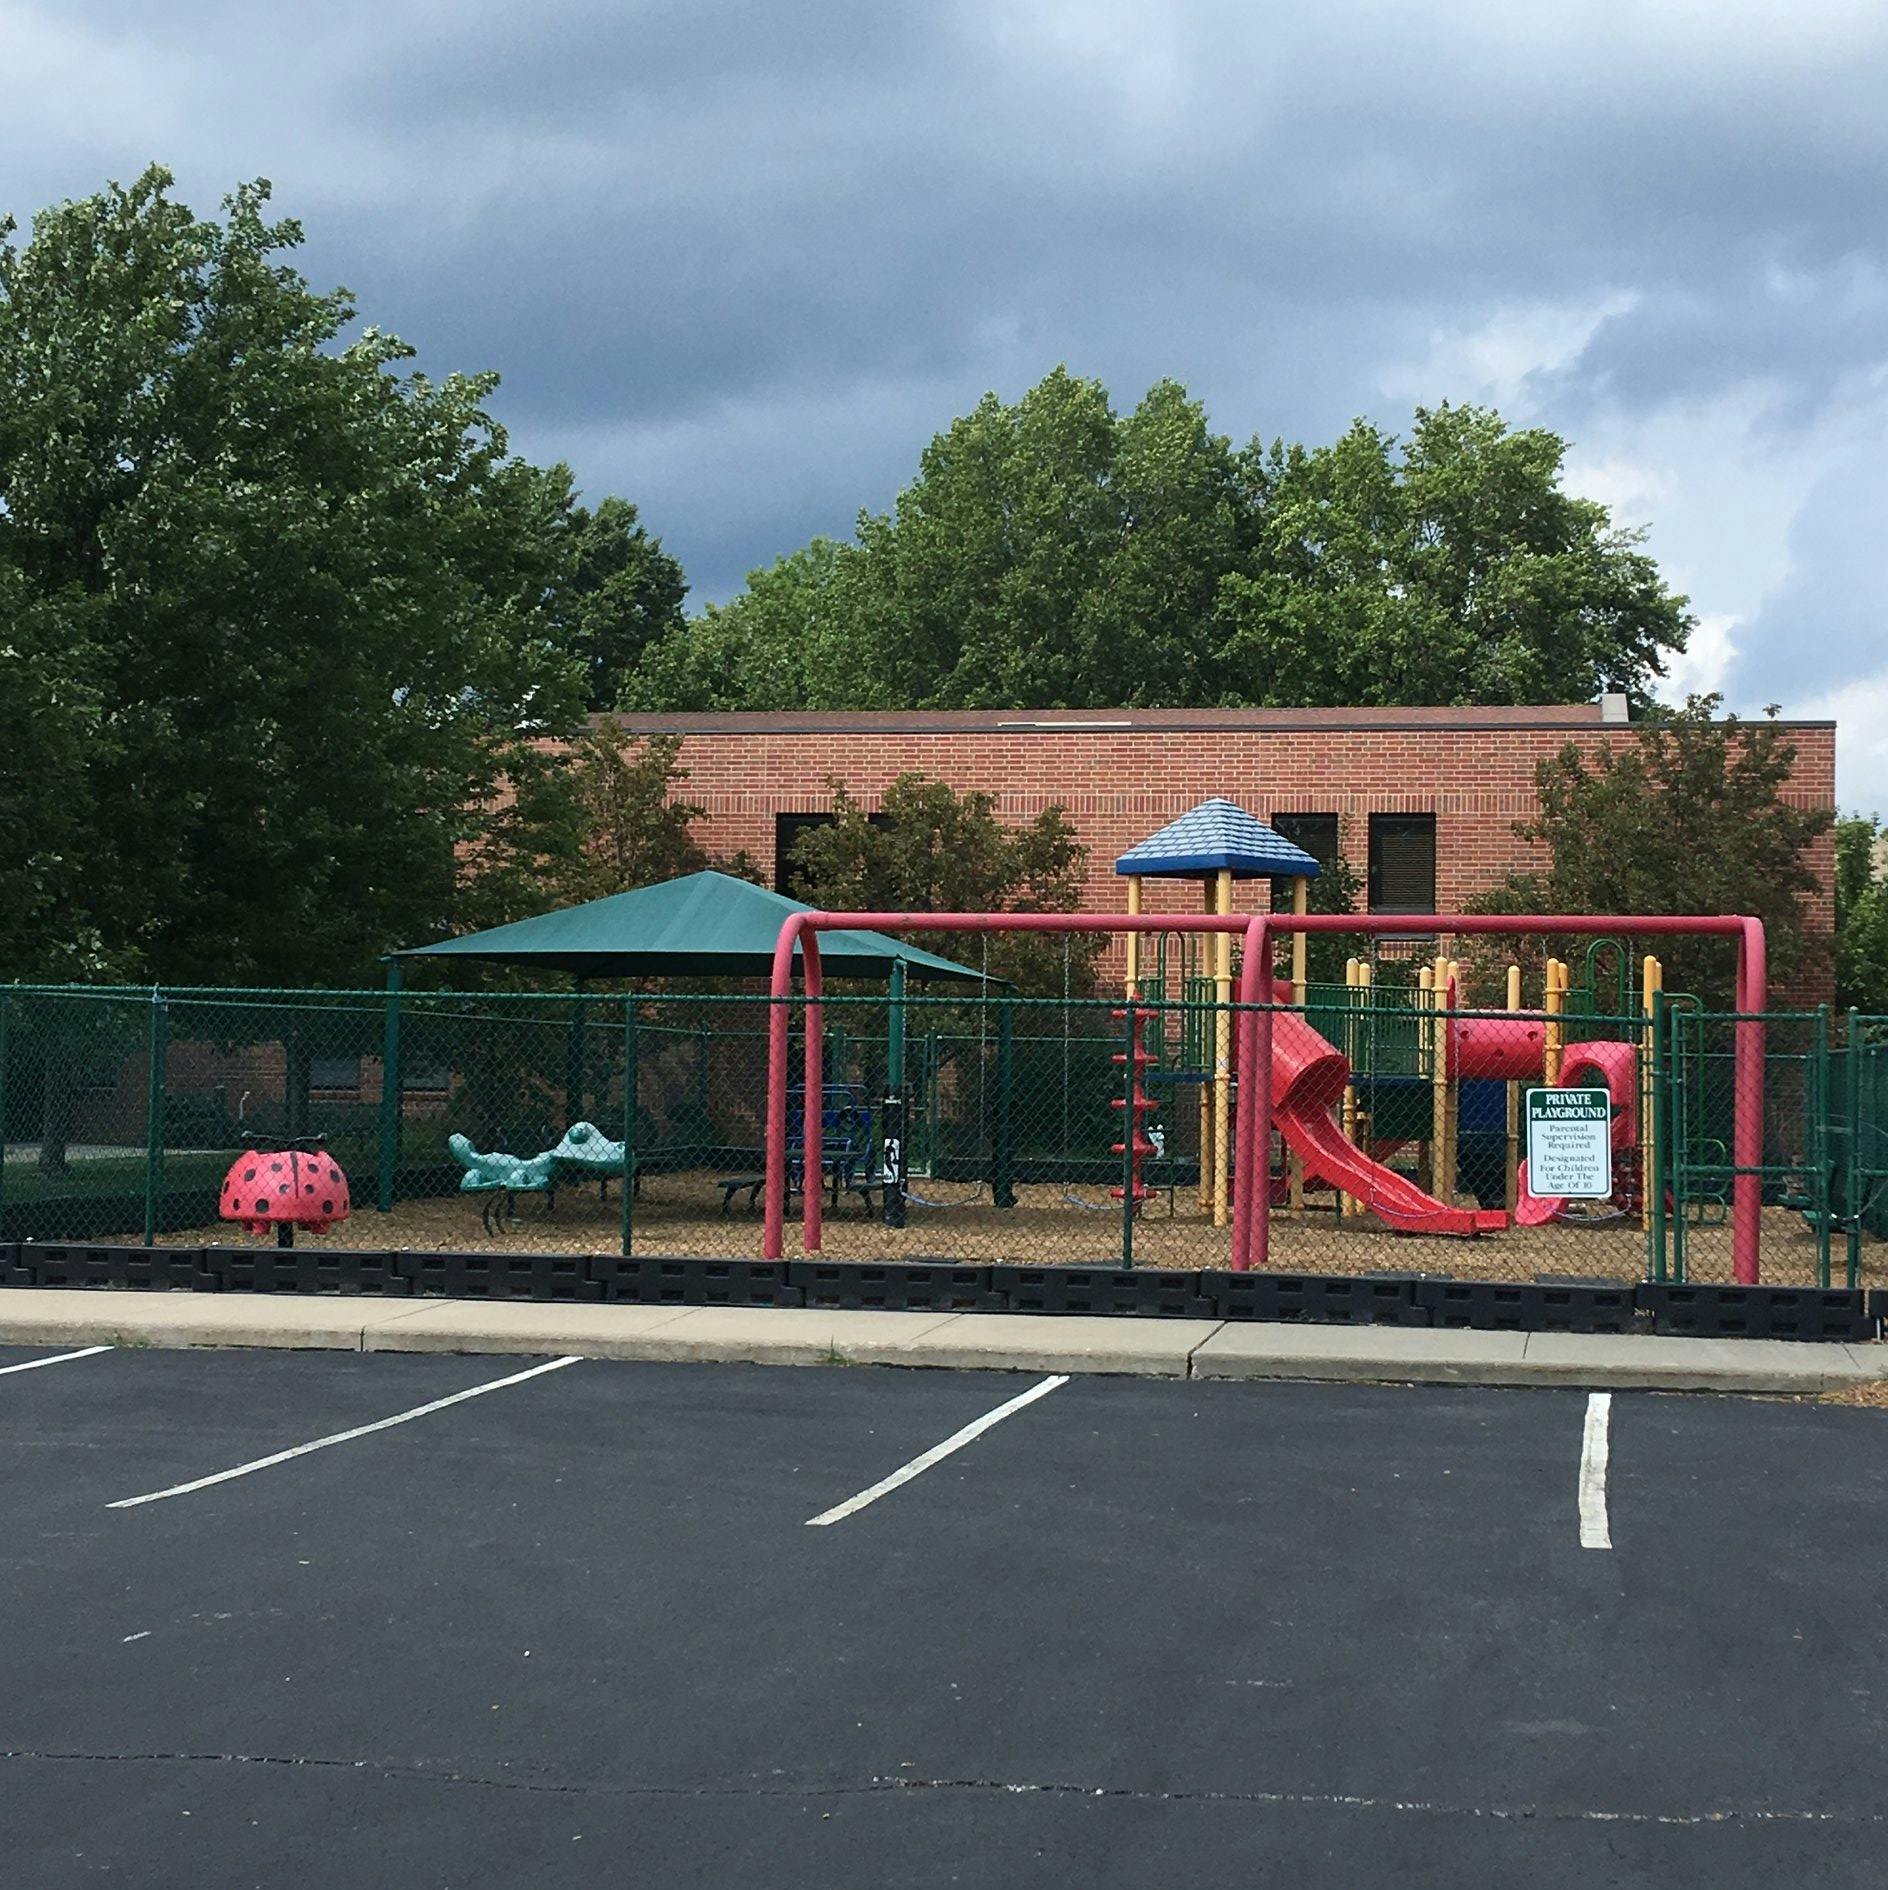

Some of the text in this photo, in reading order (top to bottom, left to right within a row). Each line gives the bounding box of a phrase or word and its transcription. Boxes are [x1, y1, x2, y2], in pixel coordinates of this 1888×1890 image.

[1546, 1094, 1591, 1105] PRIVATE
[1532, 1107, 1606, 1118] PLAYGROUND
[1549, 1124, 1588, 1132] Parental
[1541, 1134, 1596, 1142] Supervision
[1548, 1141, 1591, 1150] Required
[1544, 1154, 1595, 1163] Designated
[1540, 1164, 1599, 1172] For Children
[1545, 1172, 1594, 1180] Under The
[1549, 1181, 1564, 1190] Age
